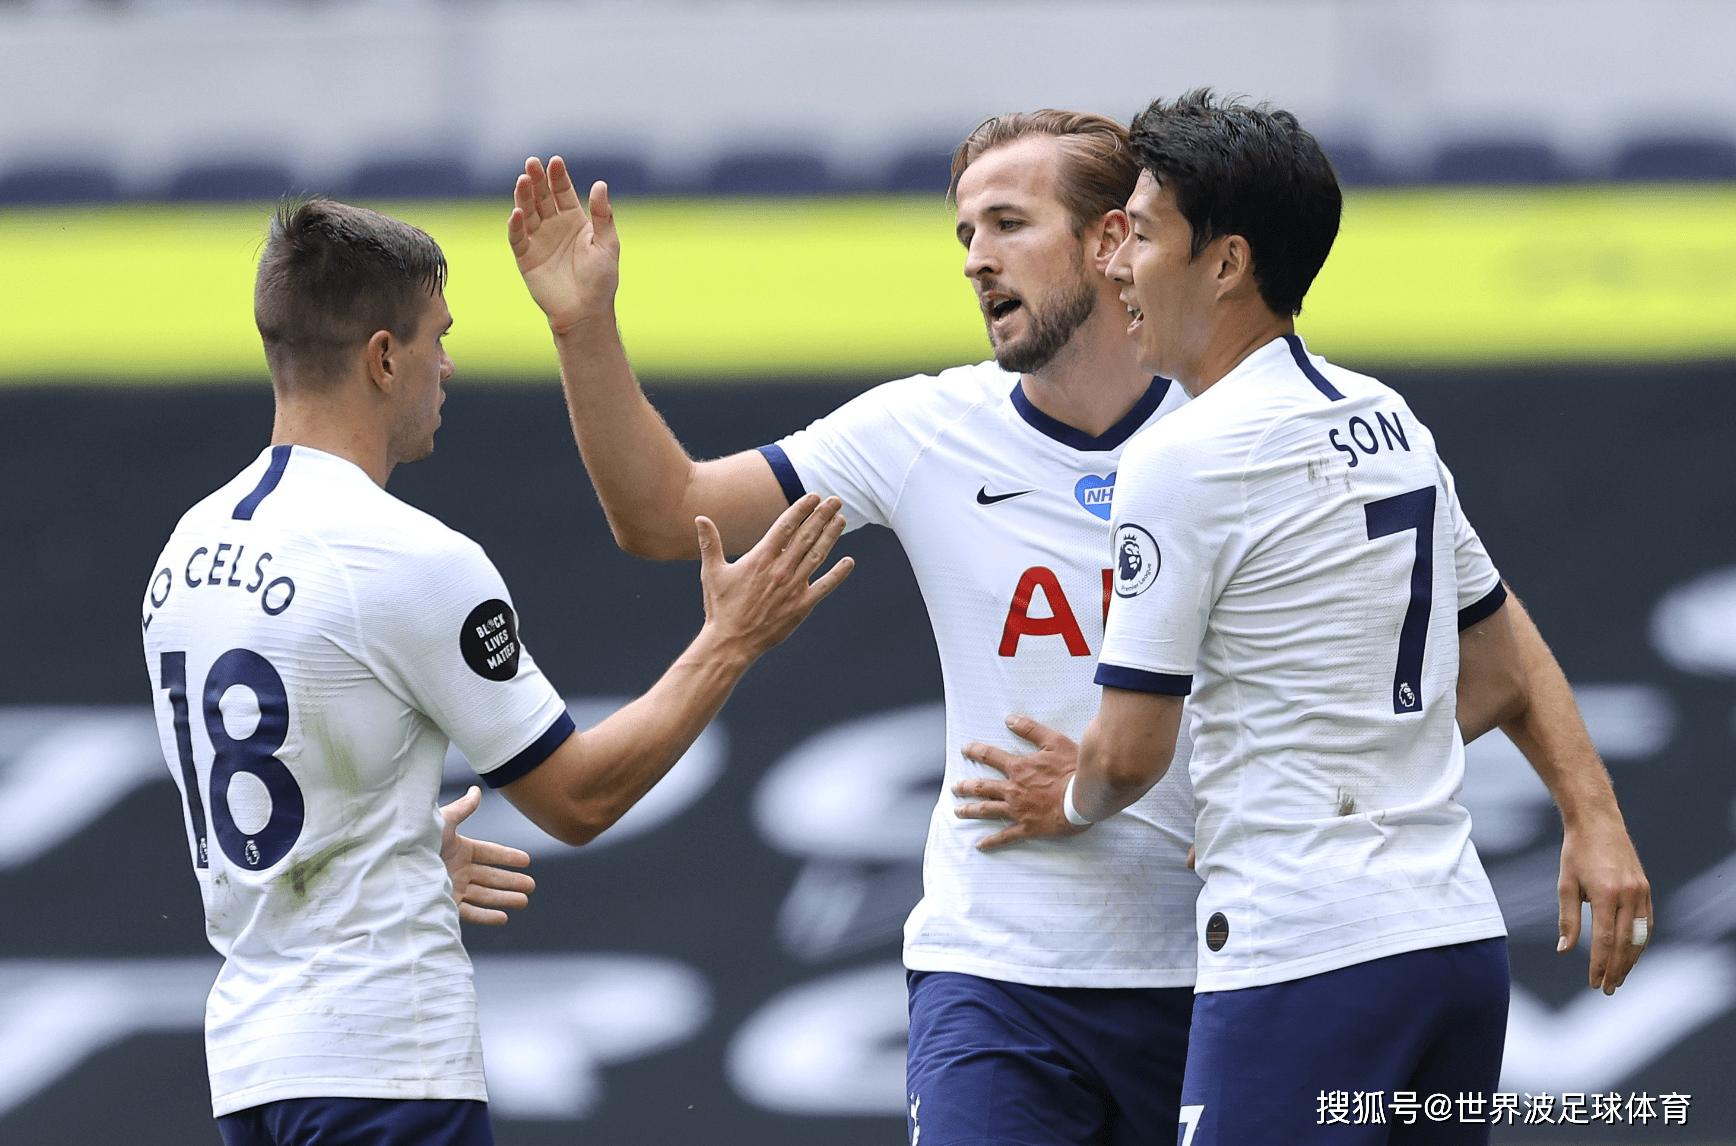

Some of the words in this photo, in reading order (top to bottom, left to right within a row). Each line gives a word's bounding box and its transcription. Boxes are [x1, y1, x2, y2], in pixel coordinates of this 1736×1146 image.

[1329, 411, 1411, 468] SON
[1086, 487, 1114, 503] NH
[185, 543, 295, 616] CELSO
[1138, 563, 1152, 585] League
[1364, 485, 1437, 715] 7
[484, 629, 509, 652] LIVES
[486, 642, 516, 670] MATTER
[160, 648, 305, 871] 18
